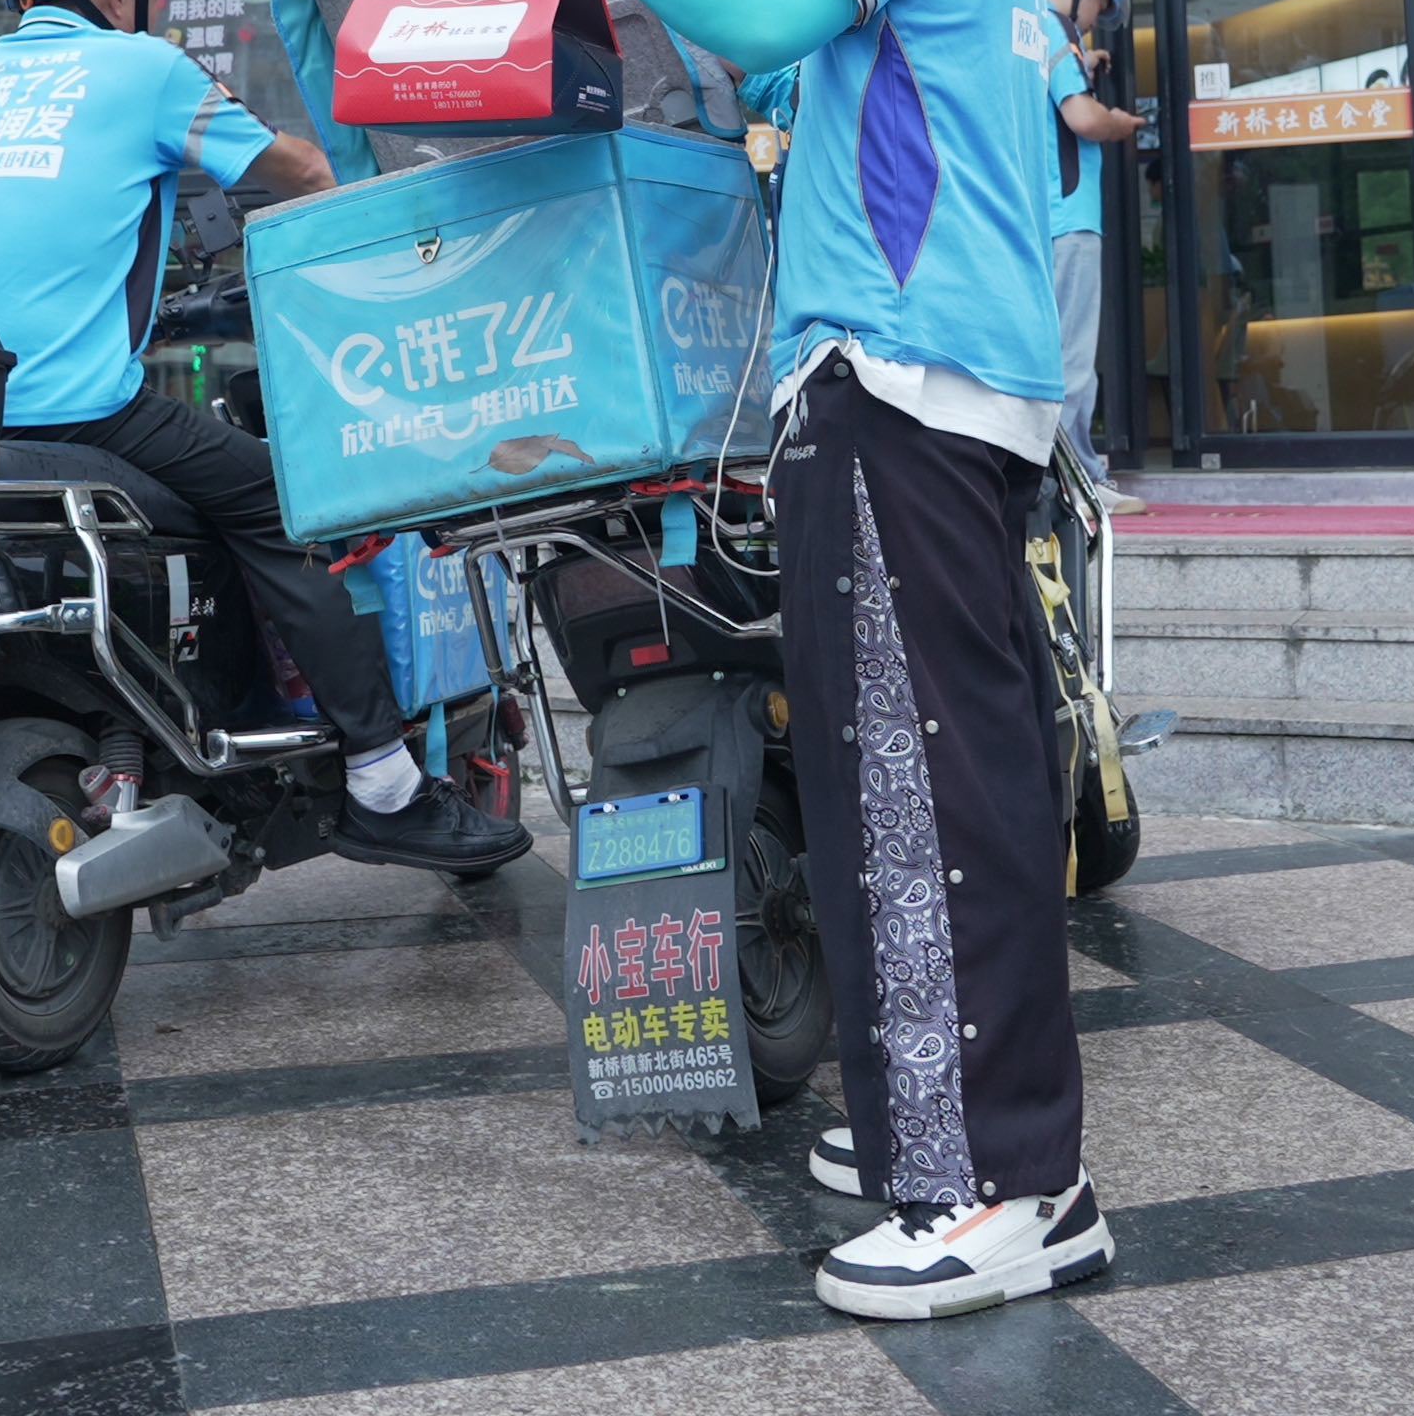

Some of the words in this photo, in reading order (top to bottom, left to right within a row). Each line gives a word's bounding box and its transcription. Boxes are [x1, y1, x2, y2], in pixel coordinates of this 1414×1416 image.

[187, 25, 225, 48] 温暖
[1199, 70, 1217, 90] 推
[1214, 98, 1392, 137] 新桥社区食堂
[395, 292, 573, 392] 饿了么
[673, 361, 732, 396] 放心点
[340, 404, 444, 458] 放心点
[472, 374, 579, 426] 准时达
[784, 444, 817, 461] ERASER
[587, 828, 692, 872] Z288476
[578, 908, 723, 1005] 小宝车行
[582, 996, 729, 1053] 电动车专卖
[588, 1044, 733, 1080] 新桥镇新北街465号
